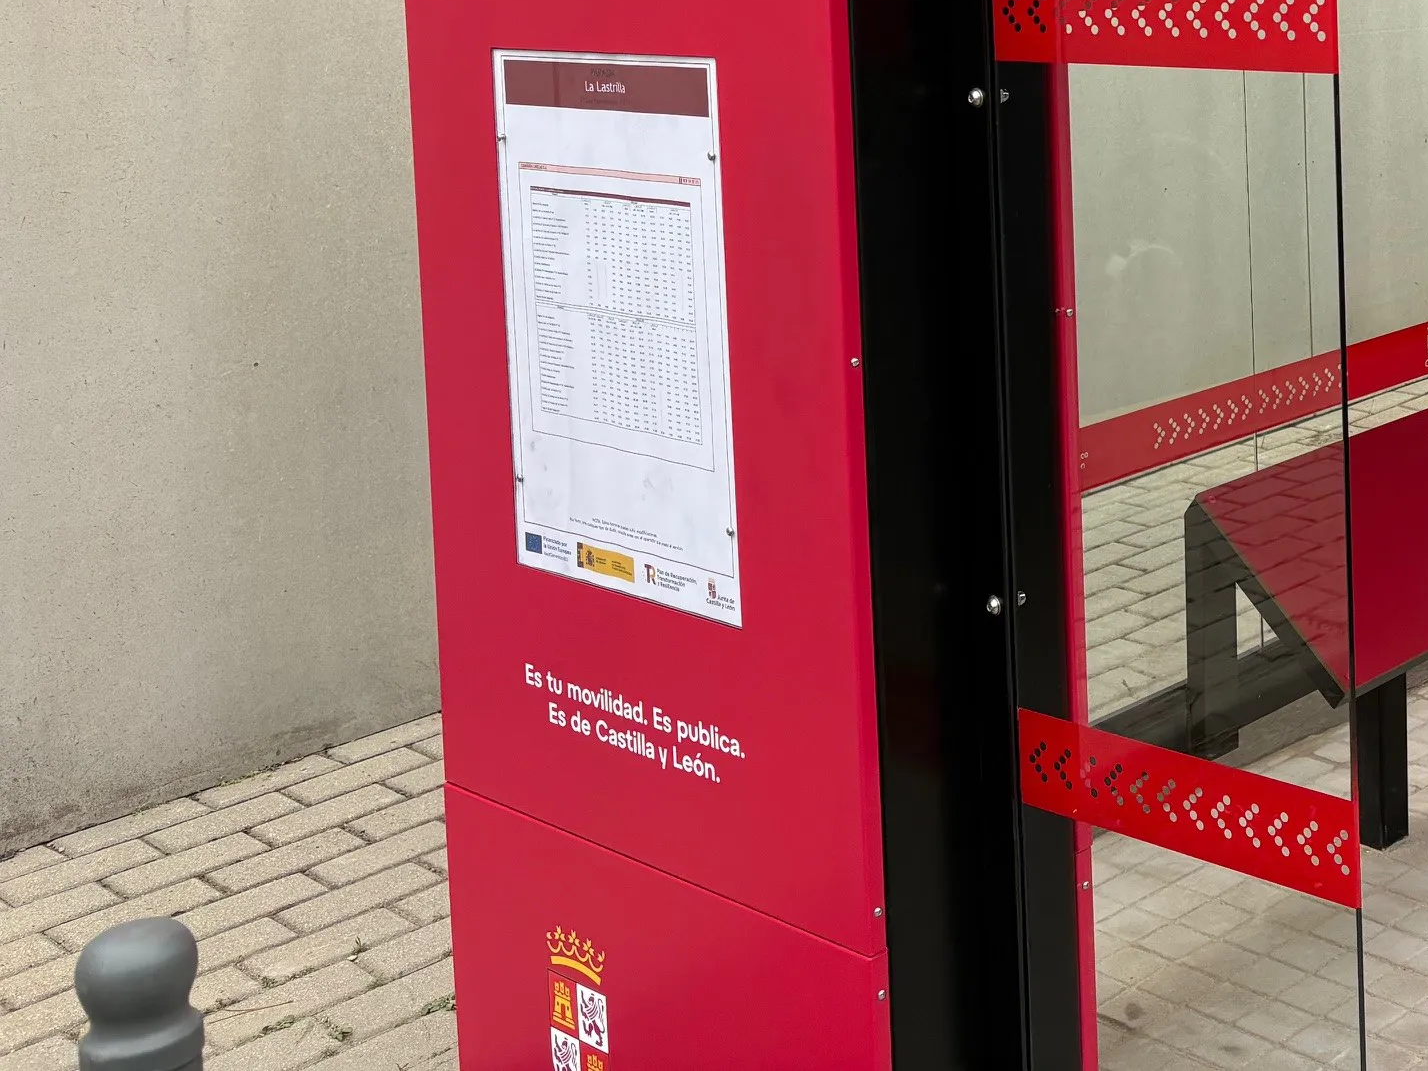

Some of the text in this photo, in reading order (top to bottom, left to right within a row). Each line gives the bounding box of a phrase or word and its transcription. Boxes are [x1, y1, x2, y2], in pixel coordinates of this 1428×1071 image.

[584, 80, 626, 94] La Lastrilla
[525, 663, 746, 759] Es tu movilidad. Es publica.
[548, 702, 721, 783] Es de Castilla y León.
